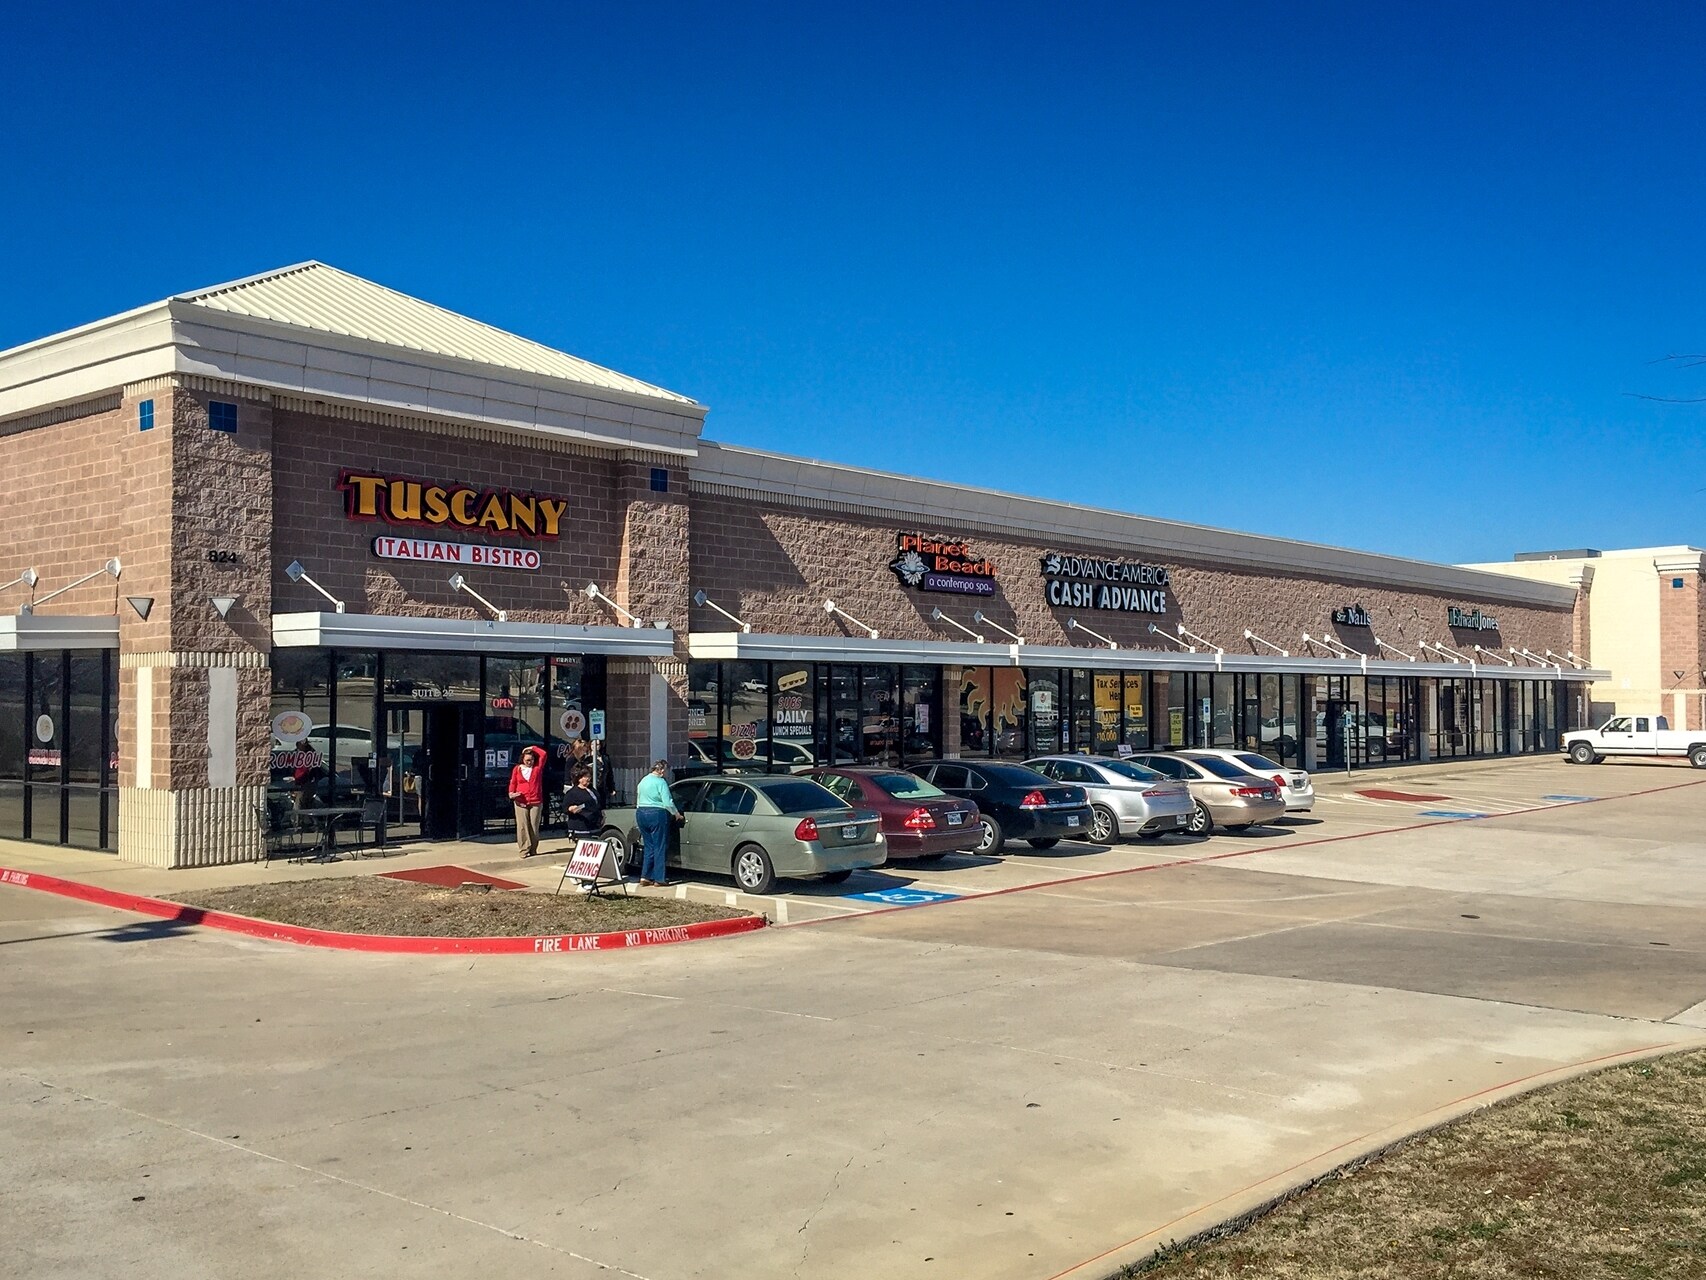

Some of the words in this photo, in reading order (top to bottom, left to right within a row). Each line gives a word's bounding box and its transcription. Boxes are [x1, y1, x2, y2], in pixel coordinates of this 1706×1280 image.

[349, 476, 567, 535] TUSCANY
[378, 538, 460, 560] ITALIAN
[472, 547, 538, 568] BISTRO
[903, 535, 970, 556] Planet
[209, 550, 237, 563] 824
[935, 556, 998, 575] Beach
[1061, 558, 1118, 580] ADVANCE
[1121, 566, 1170, 586] AMERICA
[929, 578, 935, 586] a
[936, 577, 974, 591] contempo
[1050, 580, 1093, 607] CASH
[1100, 586, 1166, 613] ADVANCE
[1348, 609, 1371, 625] Nails
[1453, 608, 1479, 627] Edward
[1479, 611, 1498, 630] Jones
[1096, 679, 1108, 688] Tax
[411, 689, 440, 698] SUITE
[492, 699, 513, 708] OPEN
[778, 697, 802, 709] SUBS
[776, 710, 808, 724] DAILY
[730, 723, 757, 737] PIZZA
[772, 726, 788, 736] LUNCH
[789, 725, 812, 736] SPECIALS
[580, 843, 601, 858] NOW
[568, 861, 600, 877] HIRING
[534, 938, 562, 952] FIRE
[569, 936, 600, 951] LANE
[625, 932, 640, 947] NO
[646, 928, 690, 943] PARKING
